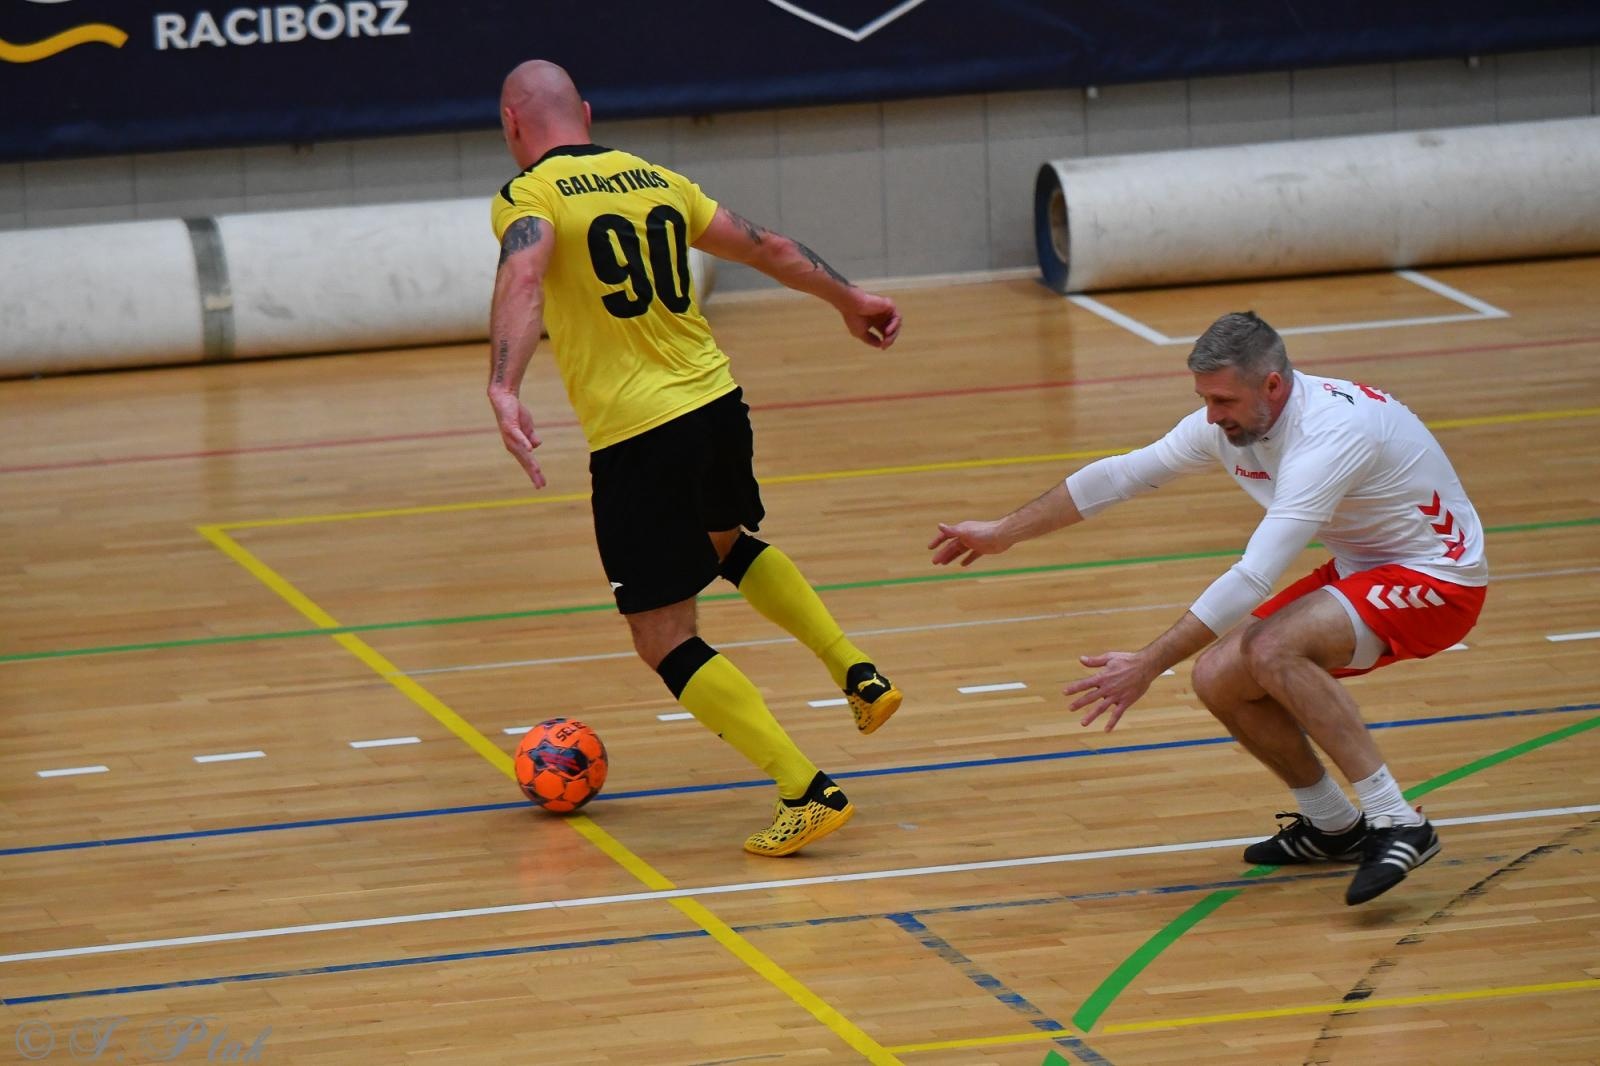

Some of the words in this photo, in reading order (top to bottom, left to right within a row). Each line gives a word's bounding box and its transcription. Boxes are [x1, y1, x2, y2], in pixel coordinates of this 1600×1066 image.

[153, 0, 411, 50] RACIBÓRZ
[555, 168, 670, 197] GALAKTIKOS
[587, 204, 691, 318] 90
